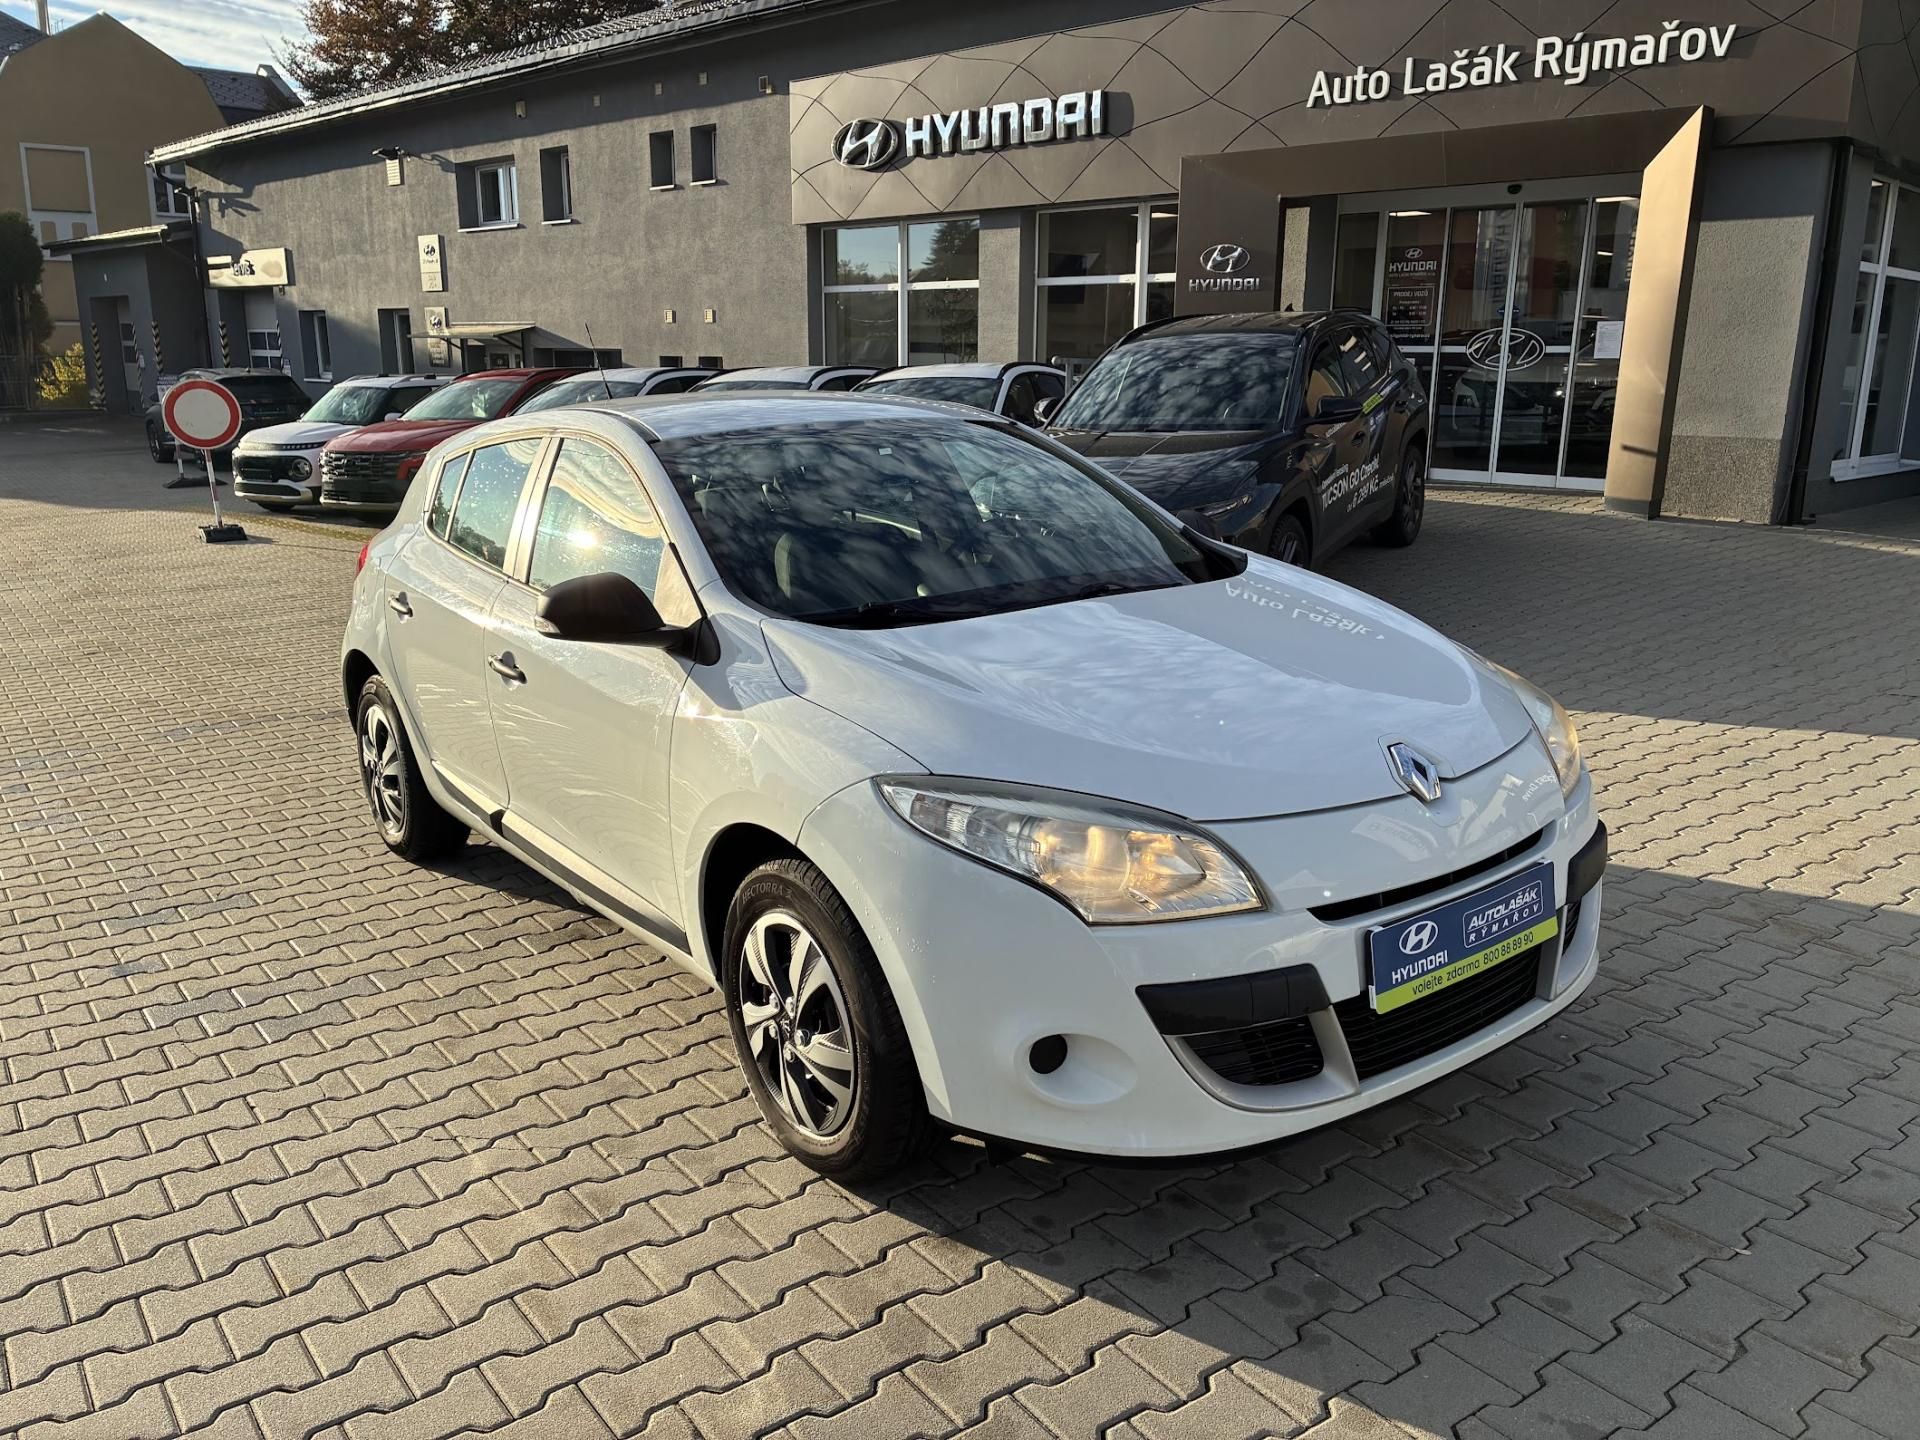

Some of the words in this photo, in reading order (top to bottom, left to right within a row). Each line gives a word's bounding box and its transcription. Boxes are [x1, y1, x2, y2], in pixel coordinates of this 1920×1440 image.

[1306, 65, 1391, 108] Auto
[1403, 44, 1521, 95] Lašák
[1534, 20, 1737, 86] Rýmařov
[905, 89, 1107, 157] HYUNDAI
[1188, 277, 1260, 292] HYUNDAI
[1388, 260, 1437, 272] HYUNDAI
[1321, 475, 1349, 512] TUCSON
[1349, 468, 1360, 489] GO
[1468, 887, 1538, 930] AUTOLAŠÁK
[1468, 903, 1540, 944] RÝMAŘOV
[1391, 950, 1449, 984] HYUNDAI
[1412, 975, 1443, 996] volejte
[1446, 959, 1480, 982] zdarma
[1483, 949, 1500, 965] 800
[1500, 943, 1511, 957] 88
[1512, 936, 1523, 951] 89
[1524, 931, 1534, 945] 90
